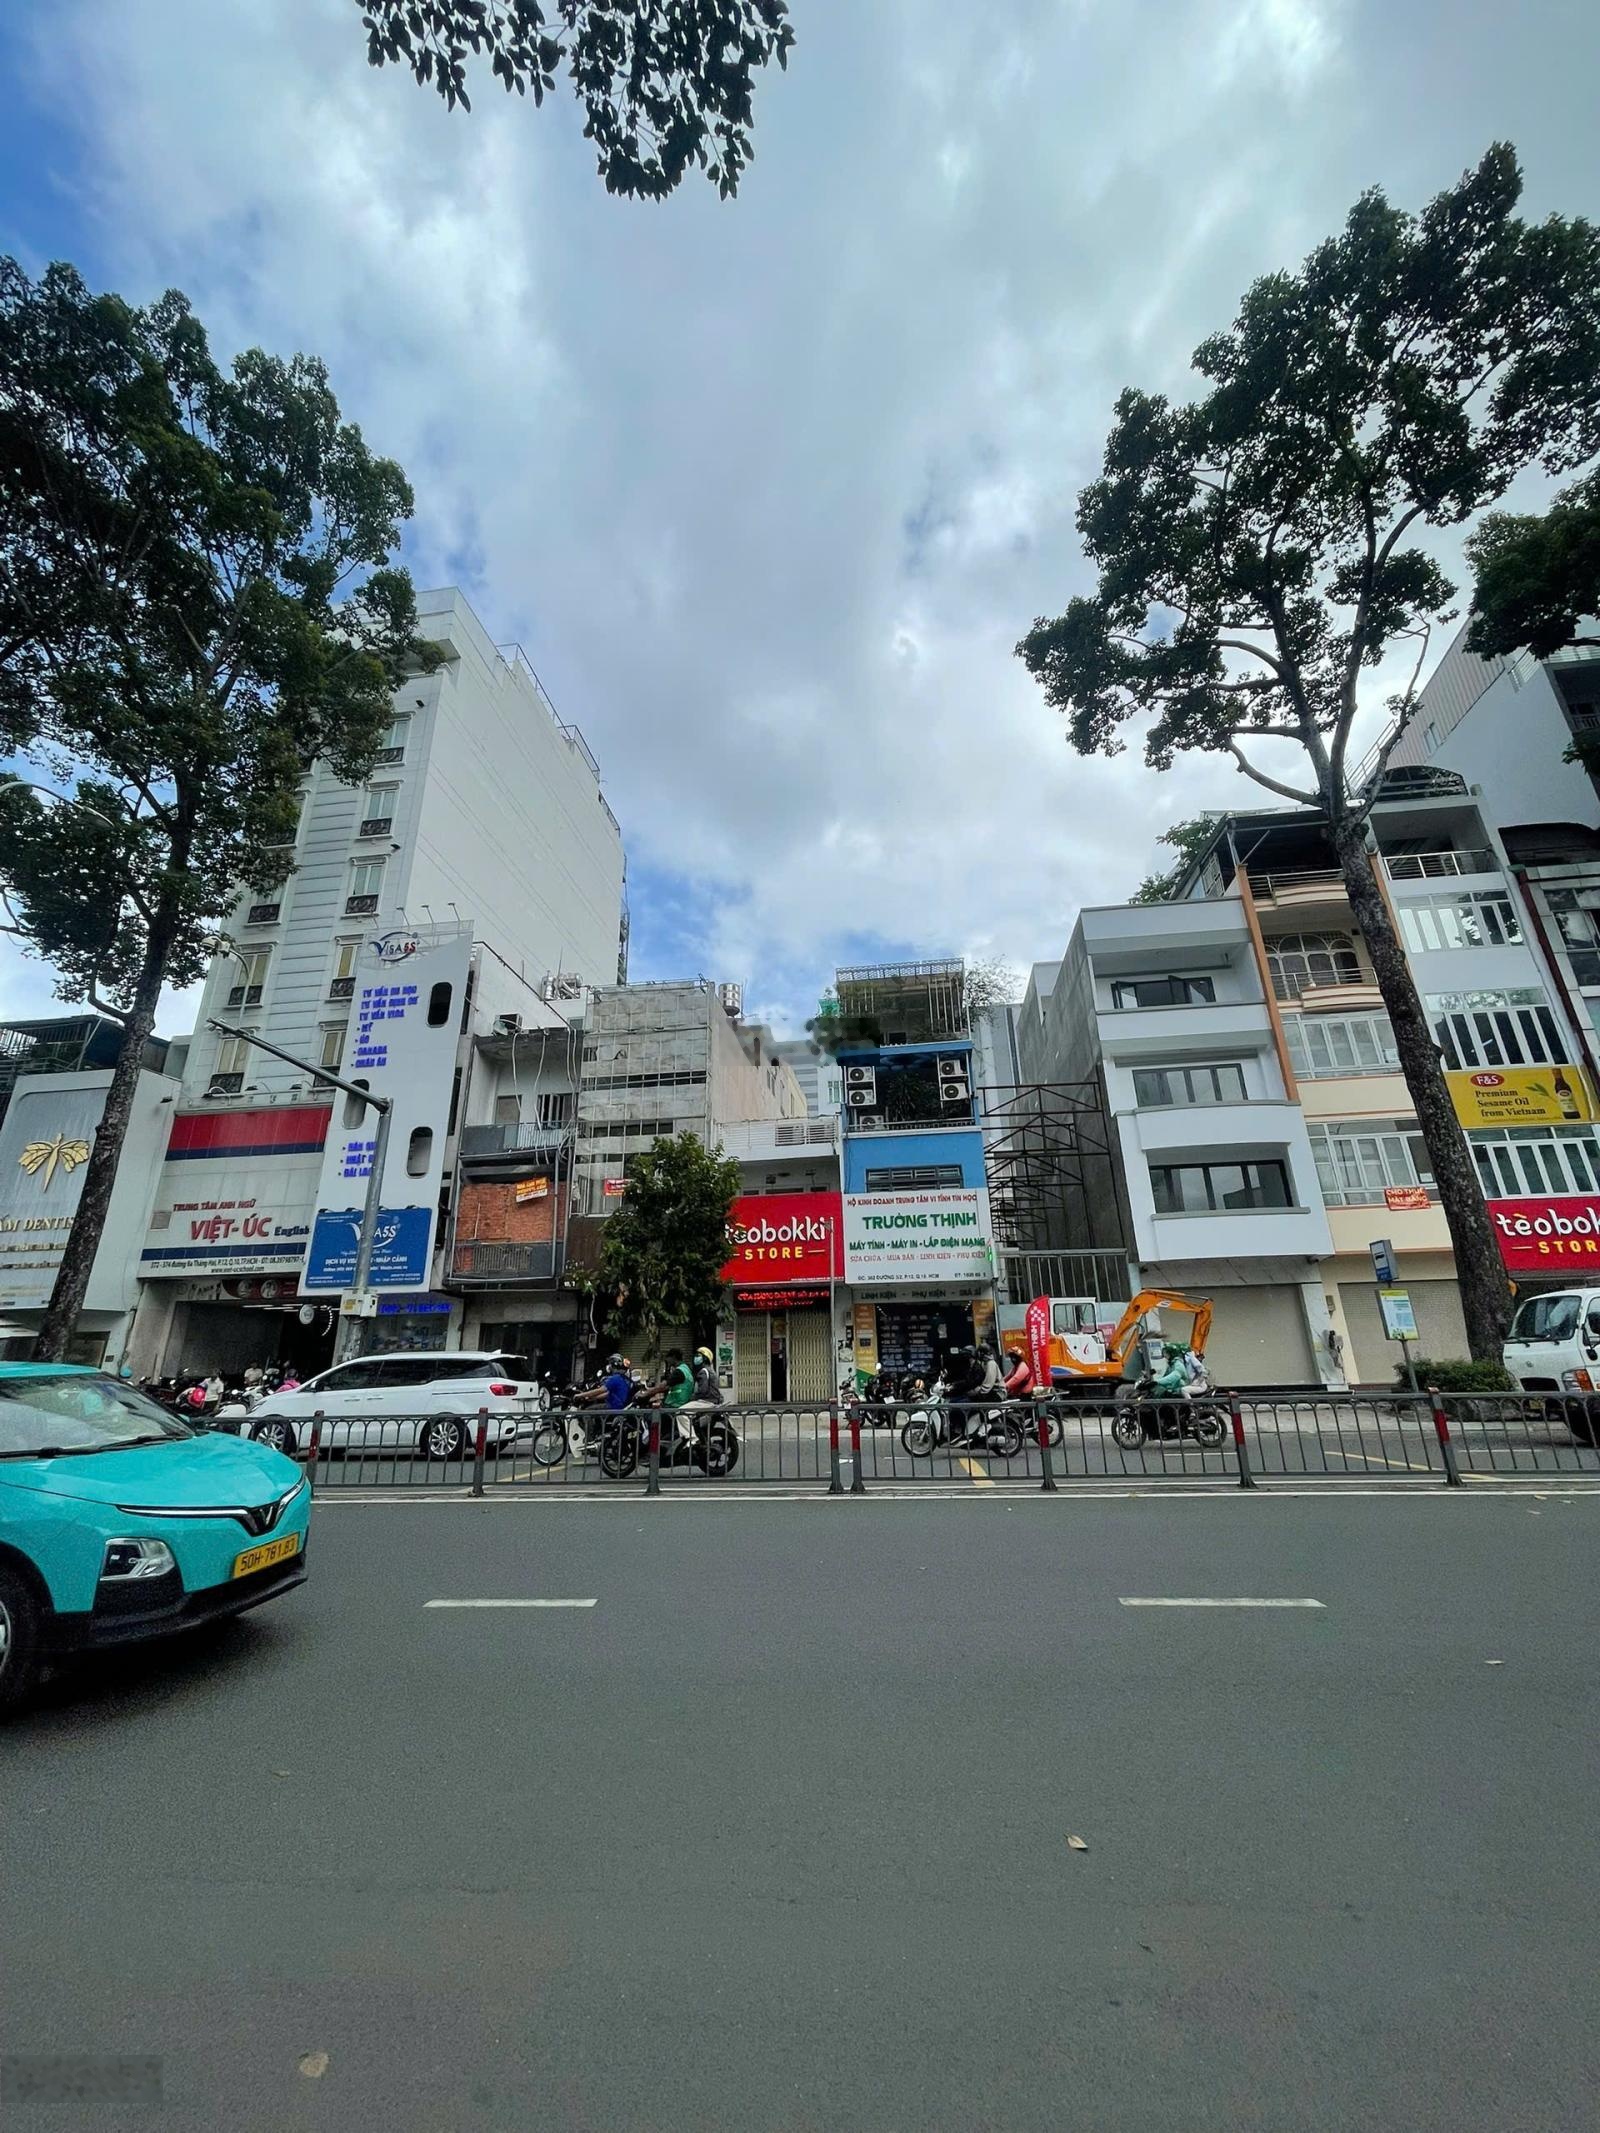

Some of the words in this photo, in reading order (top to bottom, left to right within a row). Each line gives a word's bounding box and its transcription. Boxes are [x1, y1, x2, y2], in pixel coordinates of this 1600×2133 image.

[1477, 1076, 1499, 1086] F&S
[1475, 1089, 1518, 1098] Premium
[1478, 1099, 1513, 1108] Sesame
[1515, 1097, 1530, 1106] Oil
[1481, 1108, 1504, 1117] from
[1507, 1107, 1546, 1116] Vietnam
[243, 1213, 272, 1238] ÚC
[930, 1212, 977, 1228] THỊNH
[849, 1240, 866, 1250] MÁY
[867, 1240, 885, 1250] TÍNH
[891, 1238, 908, 1248] MÁY
[910, 1240, 918, 1248] IN
[744, 1246, 804, 1260] STORE
